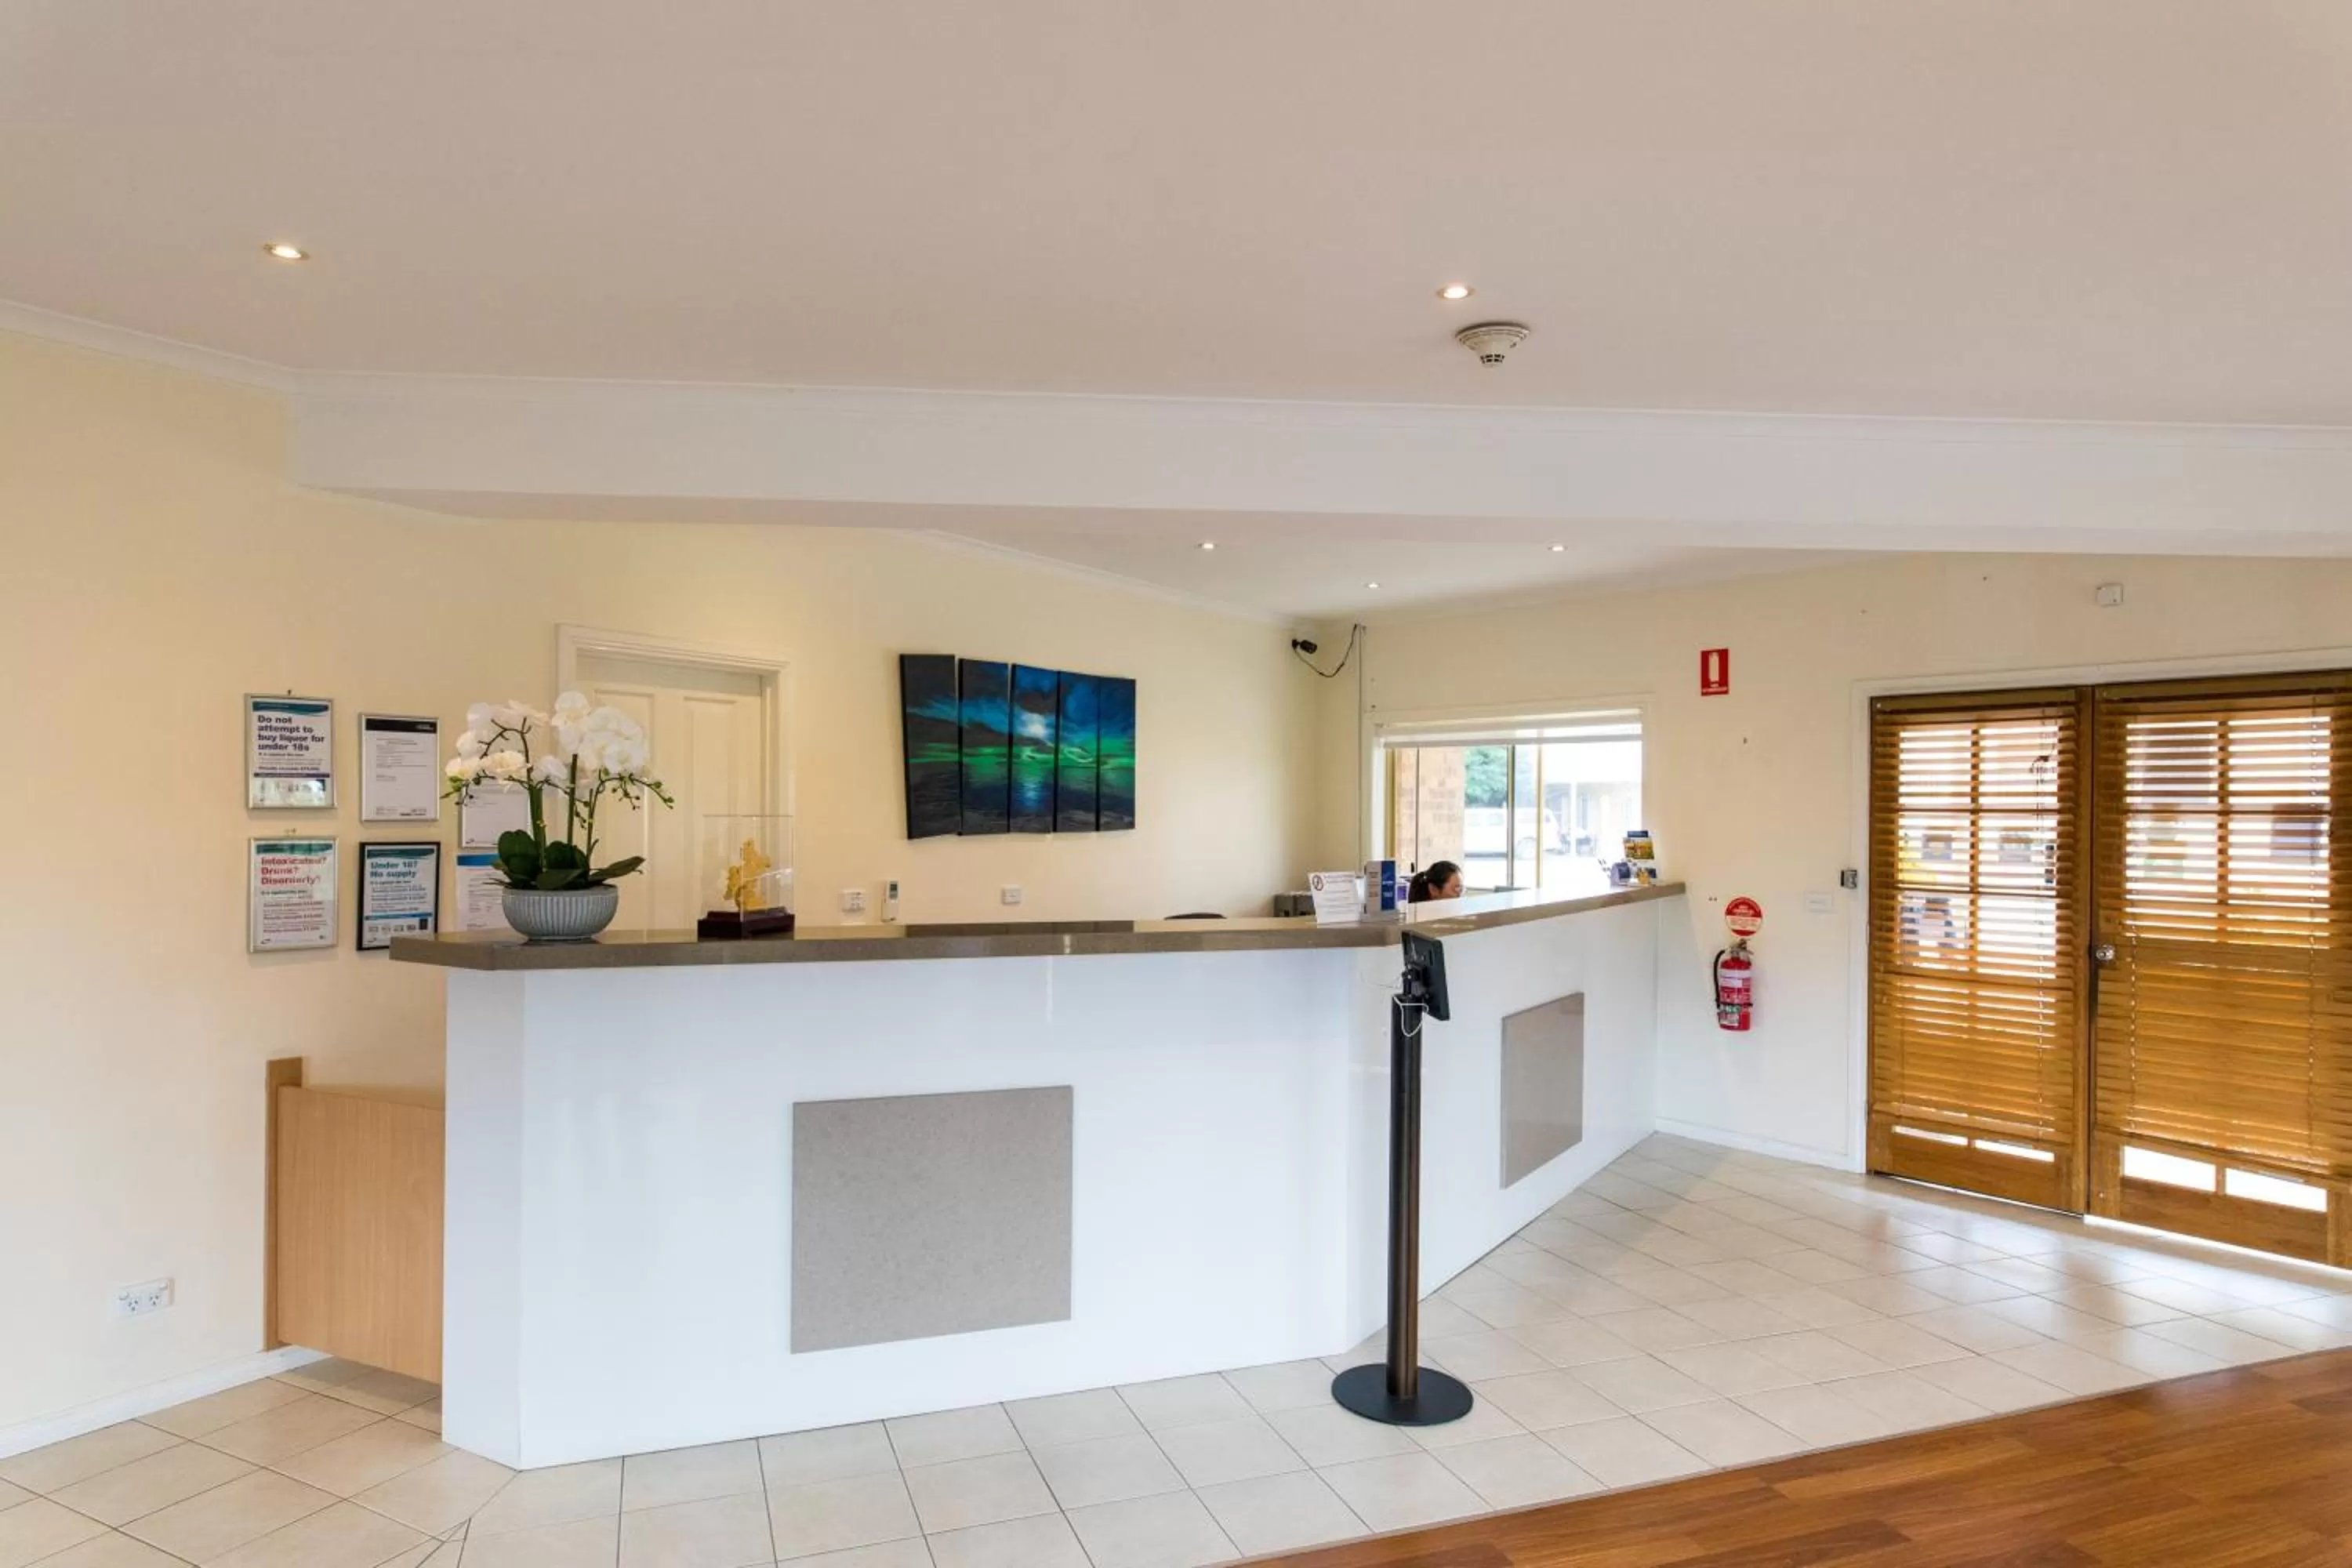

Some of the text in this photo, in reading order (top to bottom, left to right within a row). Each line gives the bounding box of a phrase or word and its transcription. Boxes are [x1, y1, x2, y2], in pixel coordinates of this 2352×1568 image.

[258, 715, 272, 724] Do
[258, 724, 300, 734] attempt
[258, 734, 277, 742] buy
[280, 734, 308, 743] liquor
[261, 866, 299, 875] Drunk?
[386, 869, 417, 878] supply
[261, 875, 321, 885] Disorderly?
